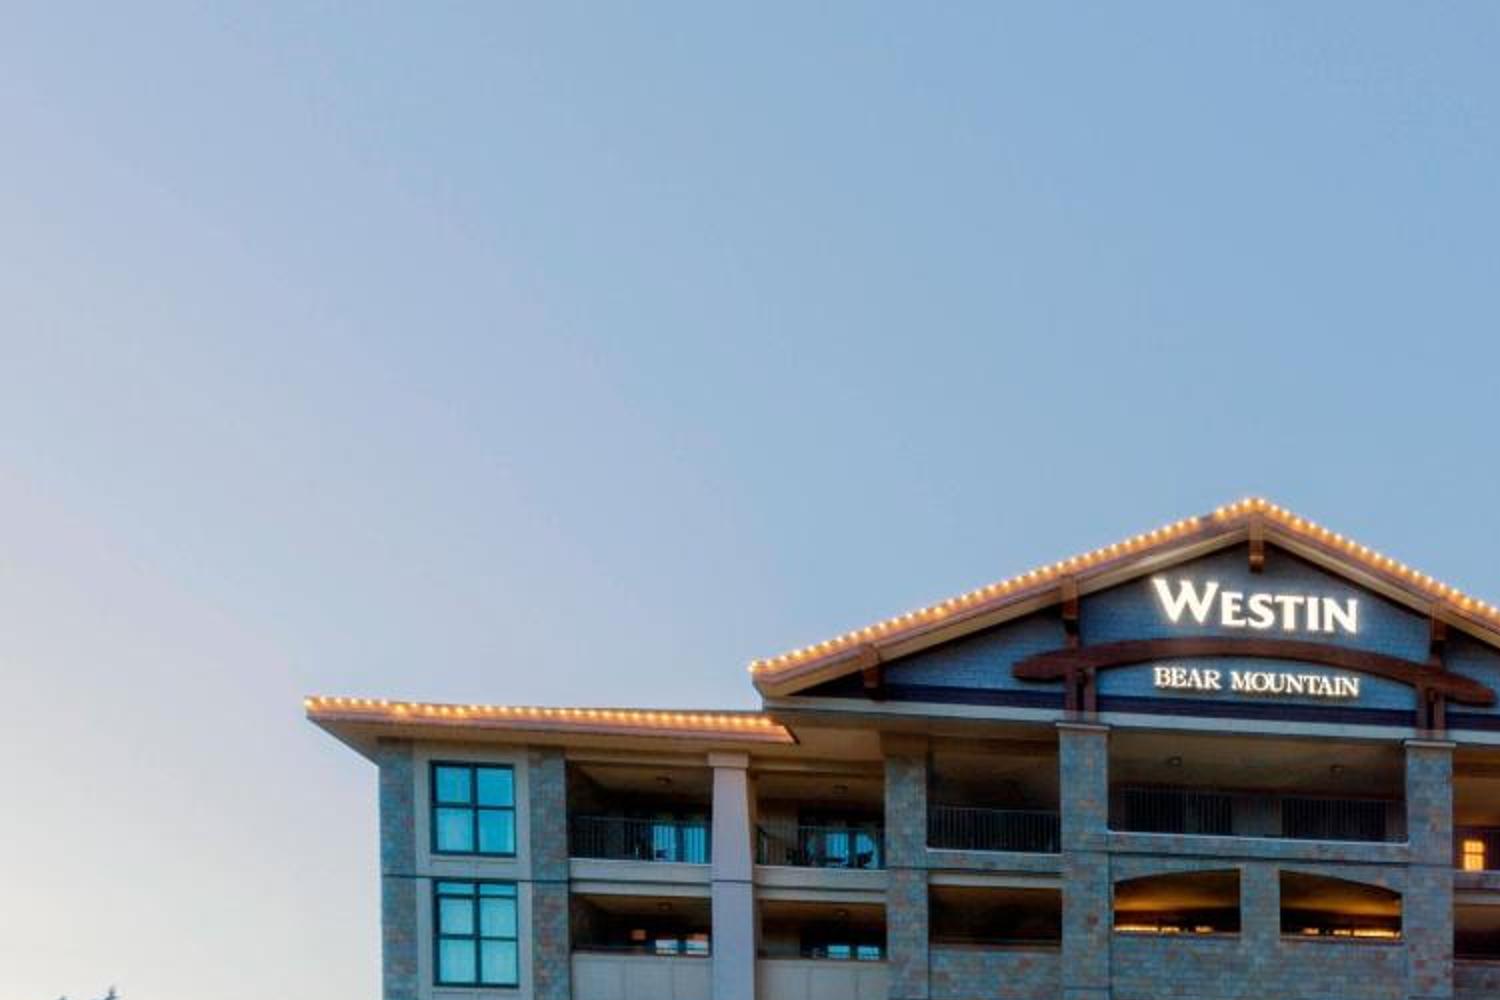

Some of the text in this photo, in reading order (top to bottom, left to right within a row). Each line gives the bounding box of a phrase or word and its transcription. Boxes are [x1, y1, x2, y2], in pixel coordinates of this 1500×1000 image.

[1152, 576, 1358, 634] WESTIN
[1153, 666, 1360, 697] BEAR MOUNTAIN
